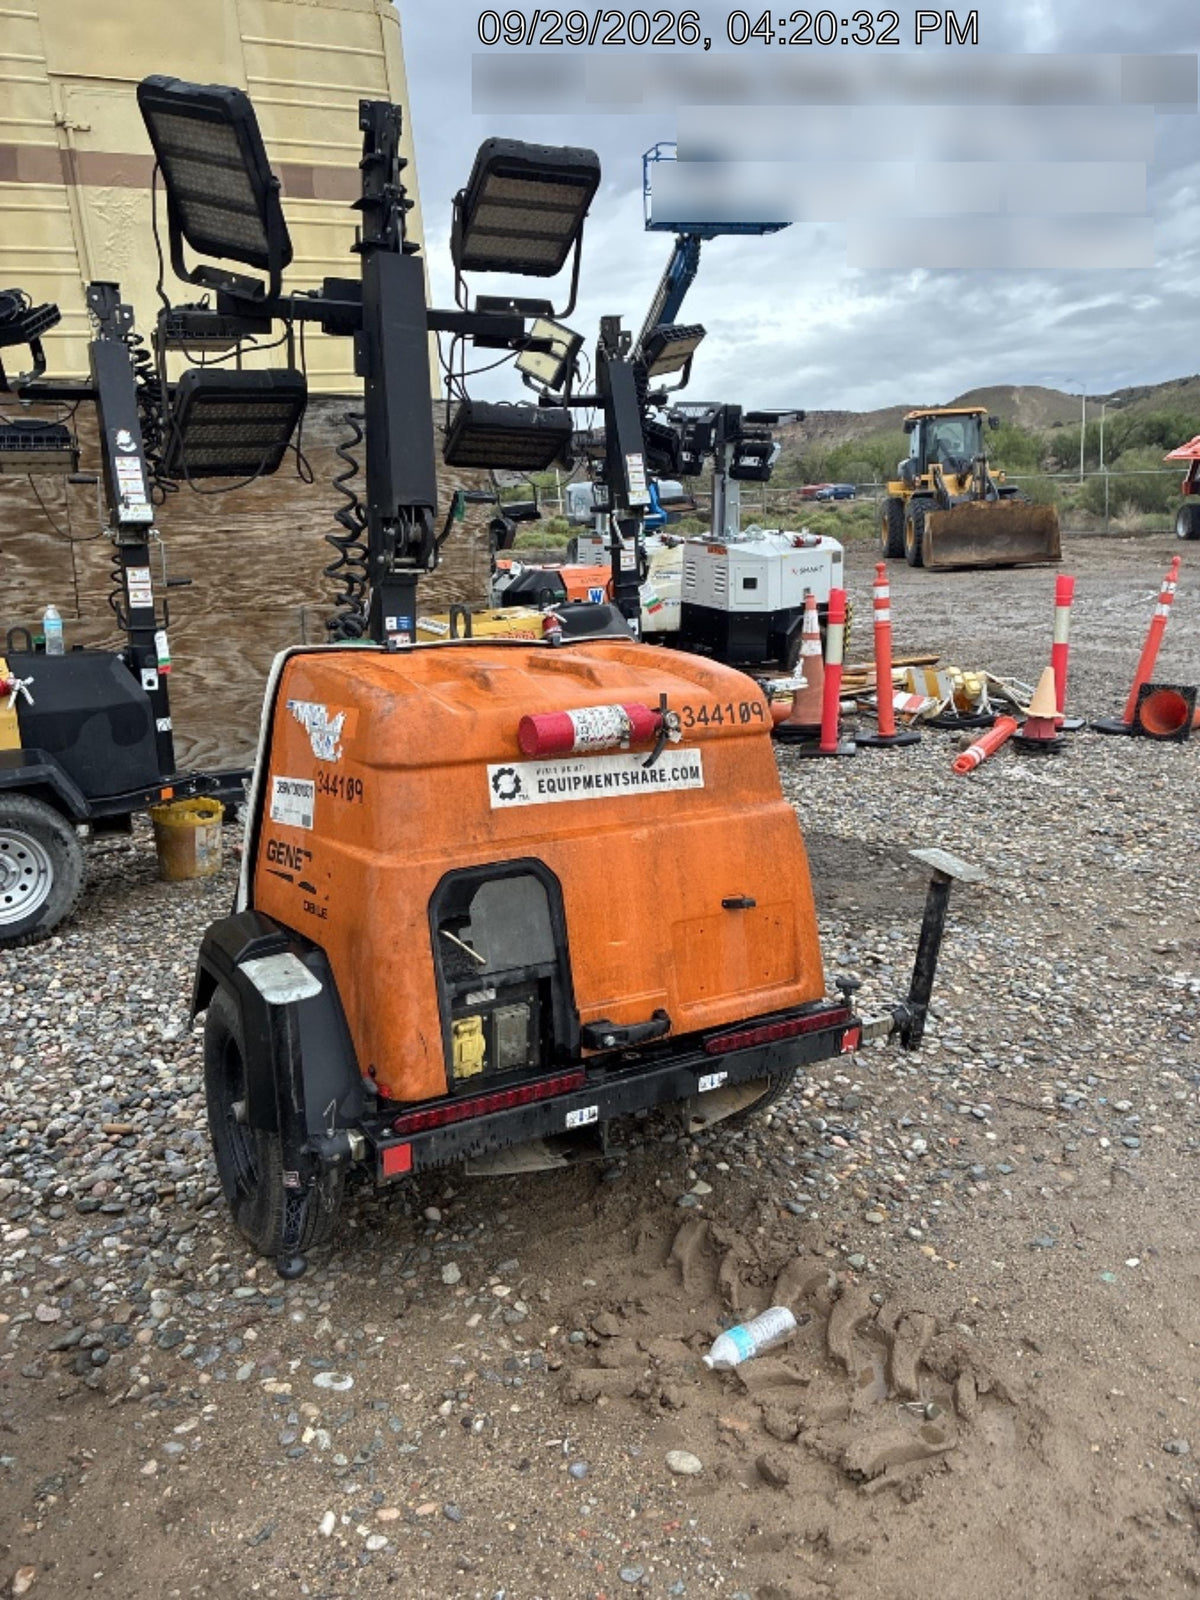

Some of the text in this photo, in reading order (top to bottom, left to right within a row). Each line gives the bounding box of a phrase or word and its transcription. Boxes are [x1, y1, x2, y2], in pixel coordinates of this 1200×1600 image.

[682, 701, 765, 728] 344109
[317, 770, 364, 804] 344109
[537, 765, 700, 794] EQUIPMENTSHARE.COM
